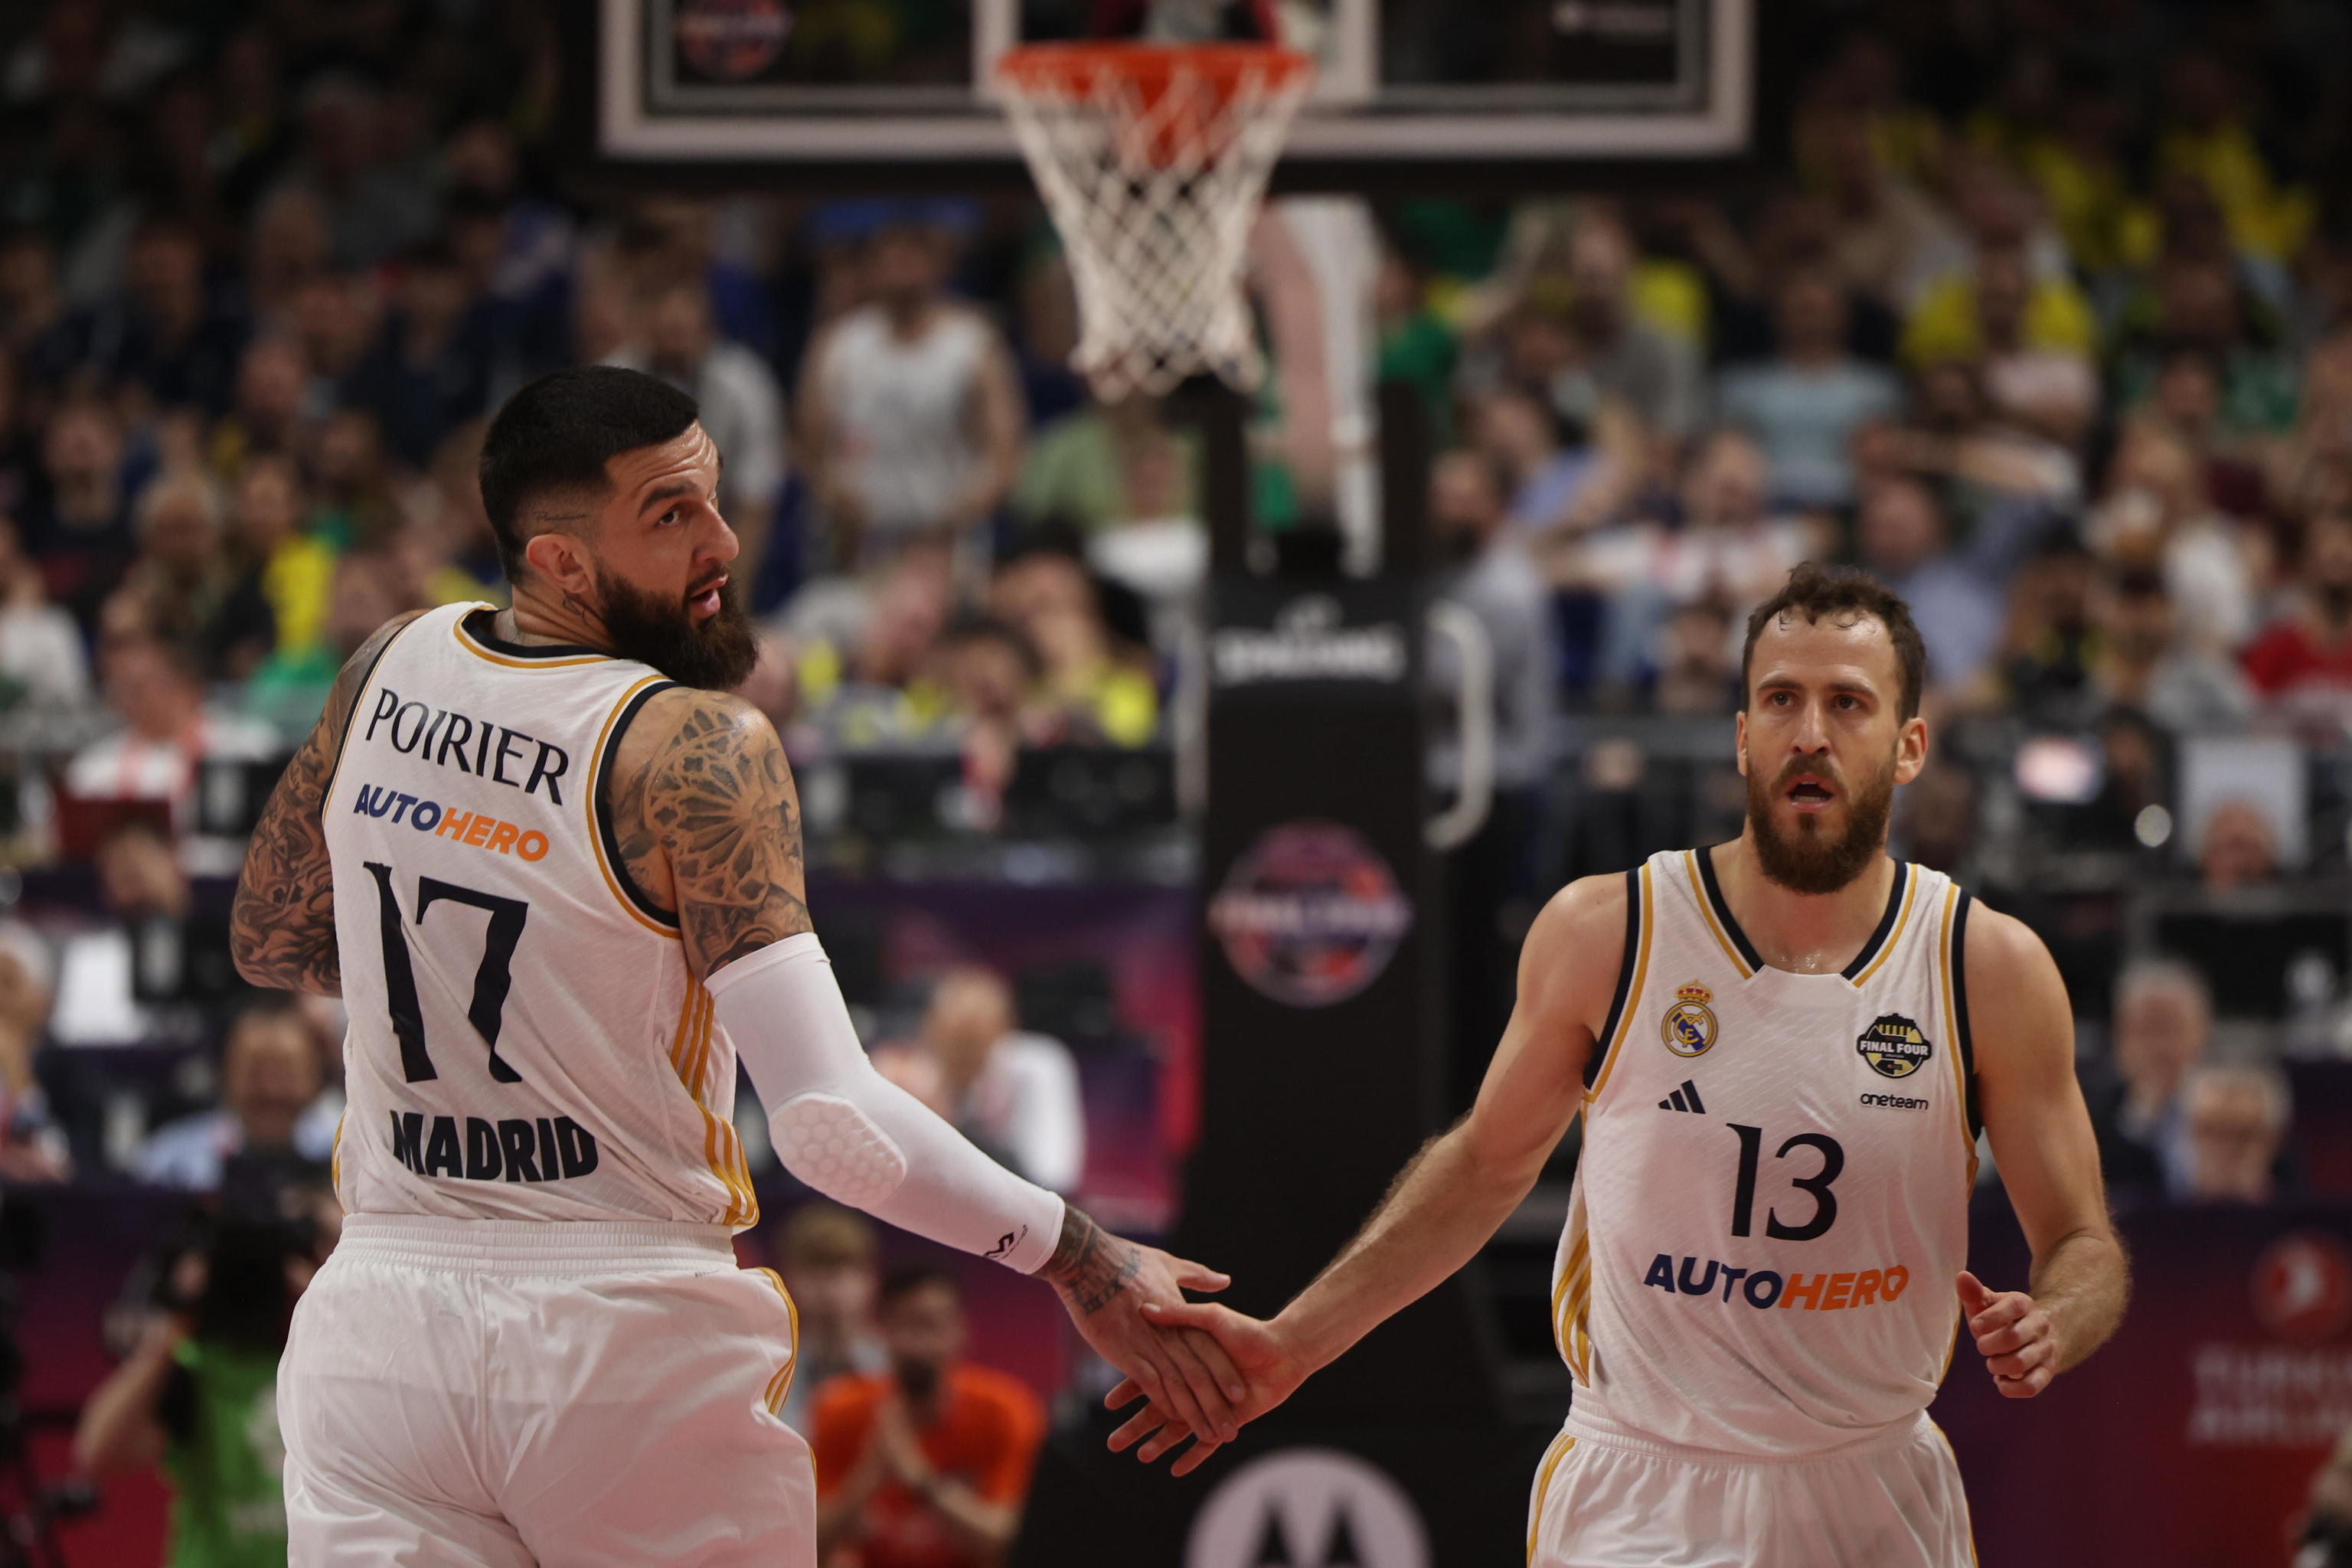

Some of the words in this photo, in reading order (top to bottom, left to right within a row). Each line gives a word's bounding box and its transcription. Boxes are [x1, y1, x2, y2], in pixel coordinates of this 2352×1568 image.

[365, 688, 569, 806] POIRIER
[353, 784, 550, 861] AUTOHERO
[363, 861, 529, 1083] 17
[1860, 1040, 1895, 1054] FINAL
[1896, 1043, 1929, 1056] FOUR
[1860, 1093, 1929, 1110] oneteam
[390, 1109, 599, 1182] MADRID
[1726, 1122, 1844, 1241] 13
[1644, 1253, 1909, 1311] AUTOHERO
